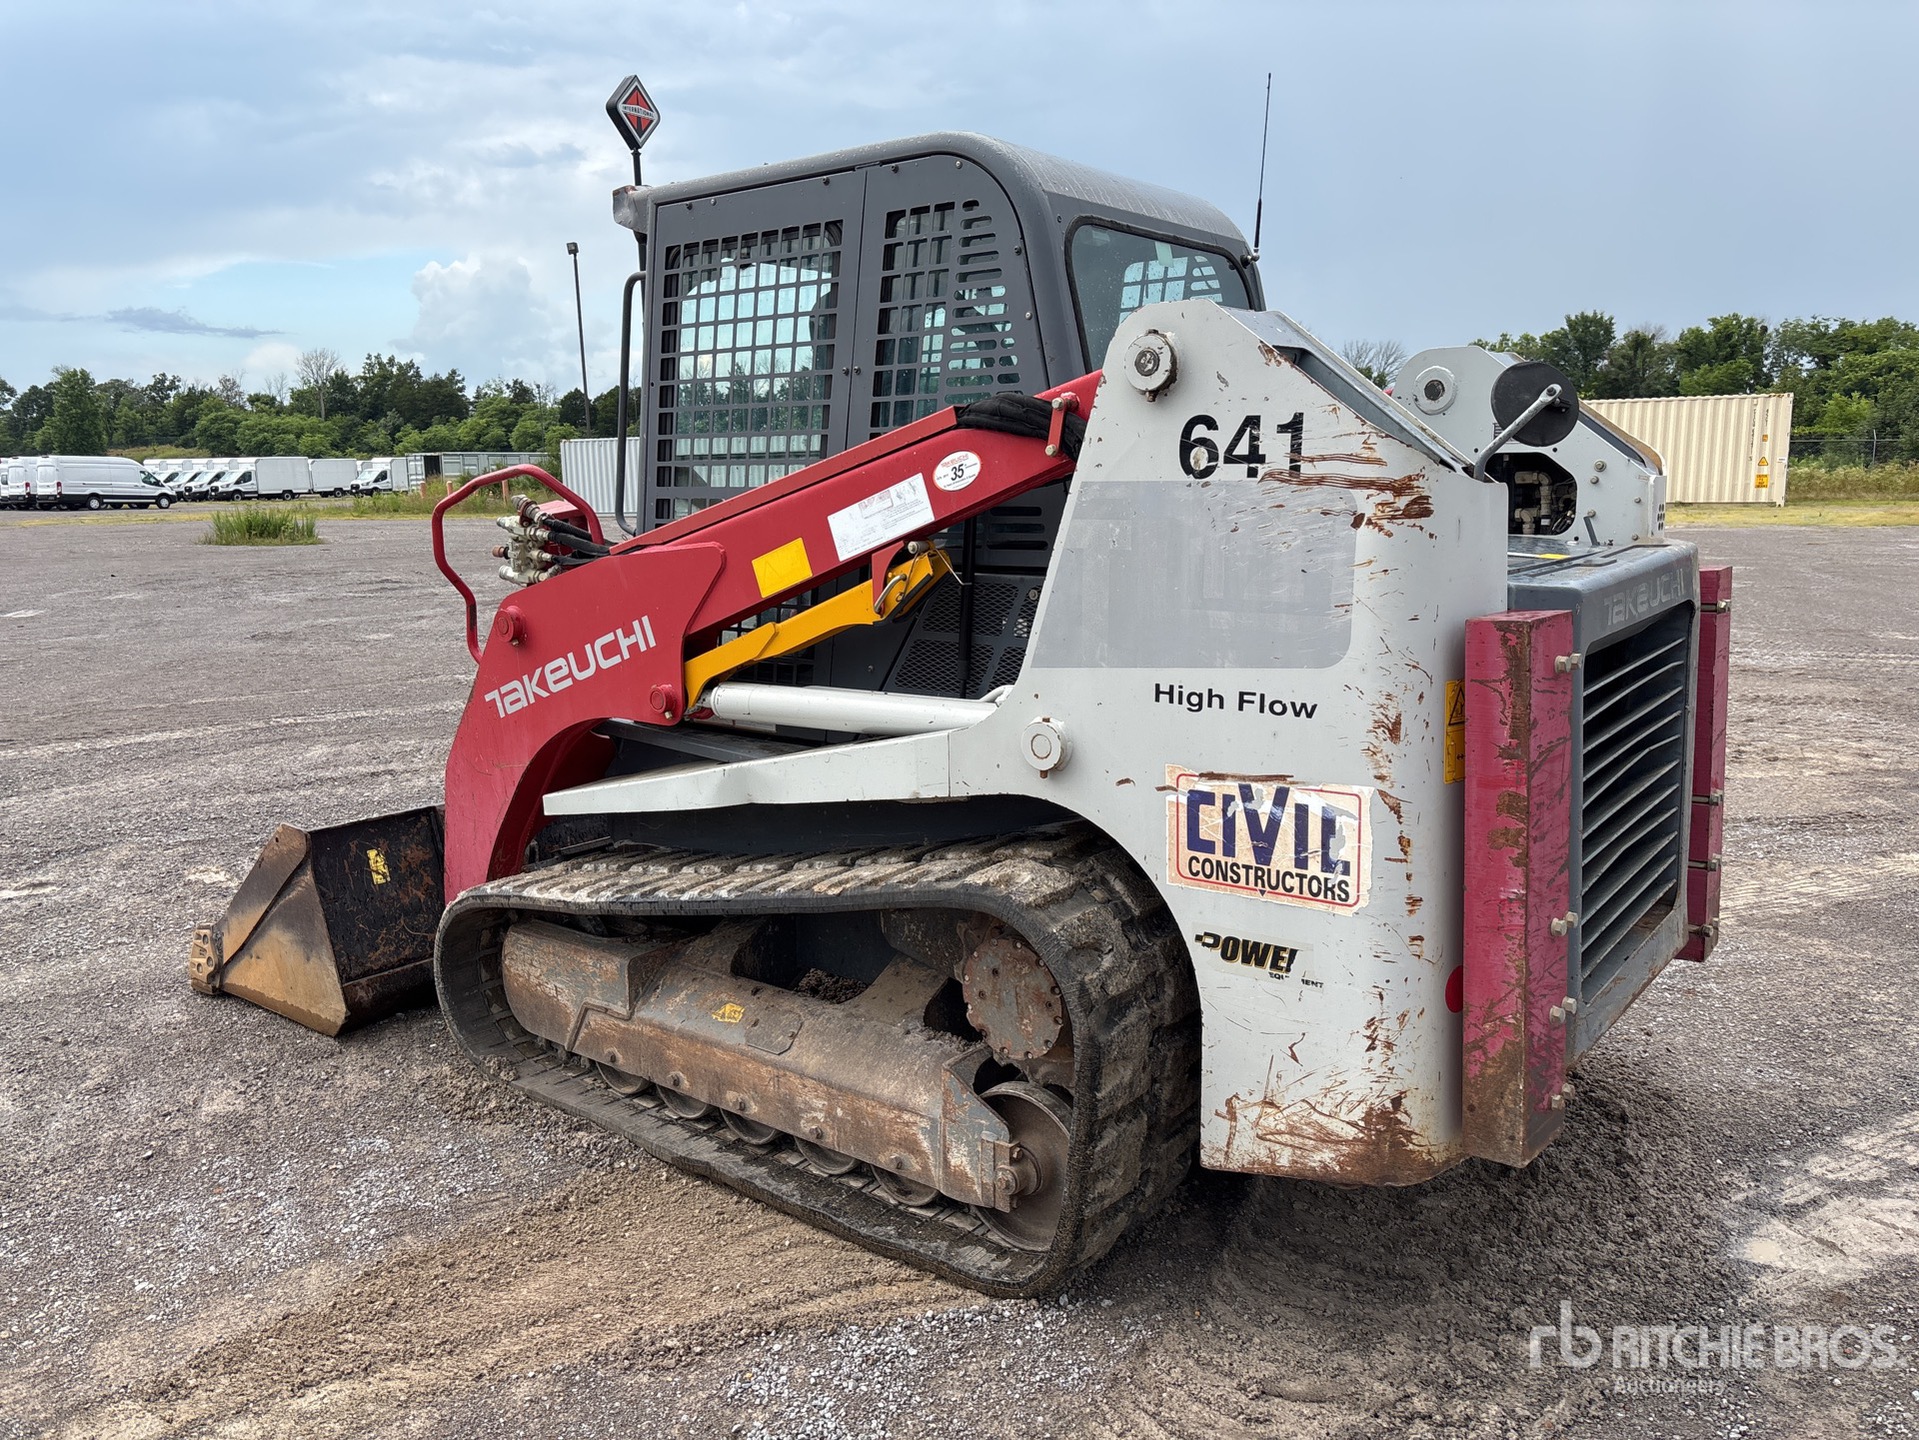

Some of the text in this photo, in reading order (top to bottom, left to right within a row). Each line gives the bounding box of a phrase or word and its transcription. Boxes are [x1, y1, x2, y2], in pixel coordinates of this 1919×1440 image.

[951, 463, 965, 481] 35
[1179, 412, 1304, 480] 641
[484, 615, 657, 719] TAKEUCHI
[1154, 683, 1318, 719] High Flow
[1187, 783, 1351, 876] CIVIL
[1188, 855, 1350, 903] CONSTRUCTORS
